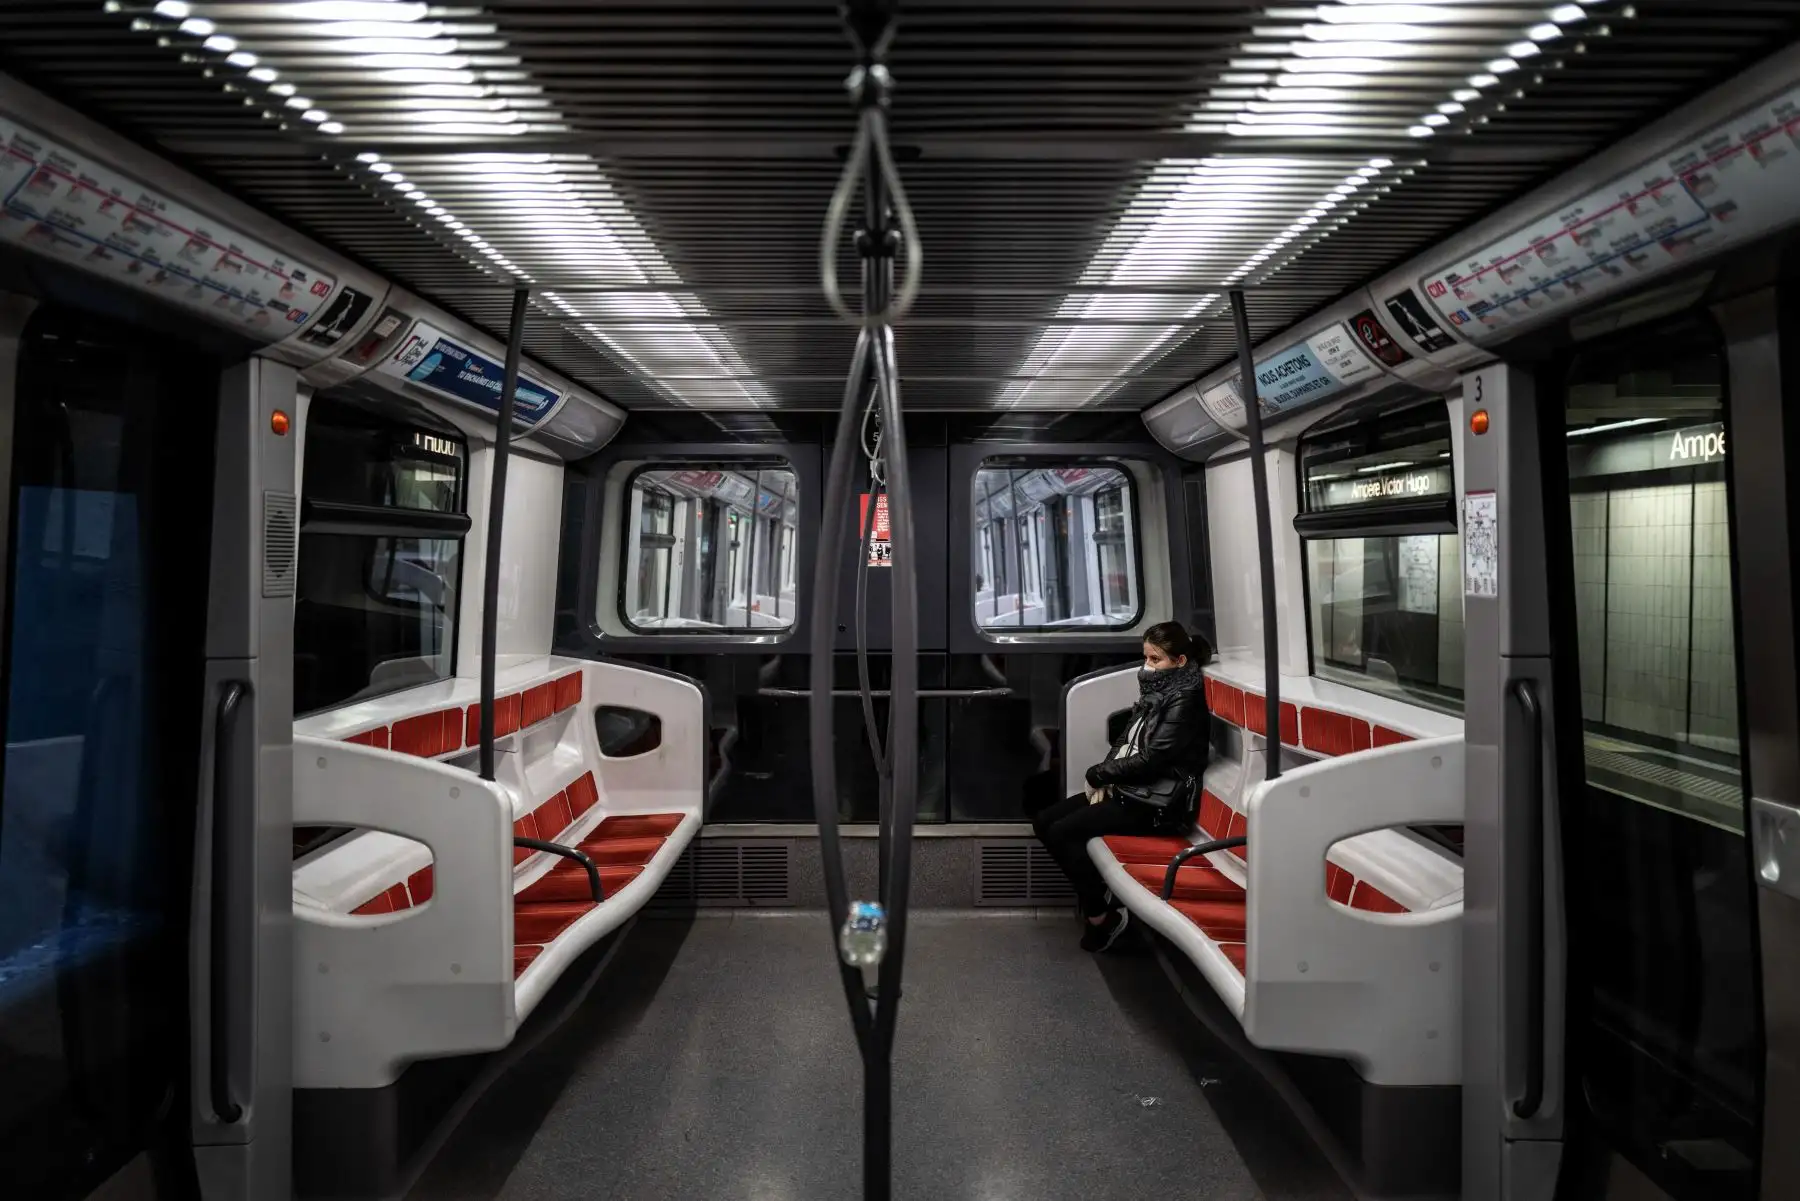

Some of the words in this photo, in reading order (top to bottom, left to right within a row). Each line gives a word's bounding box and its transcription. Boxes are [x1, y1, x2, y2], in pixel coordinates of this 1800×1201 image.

[1257, 369, 1279, 387] NOUS
[1274, 353, 1312, 379] ACHETONS
[1475, 375, 1483, 402] 3
[1405, 472, 1430, 496] Hugo
